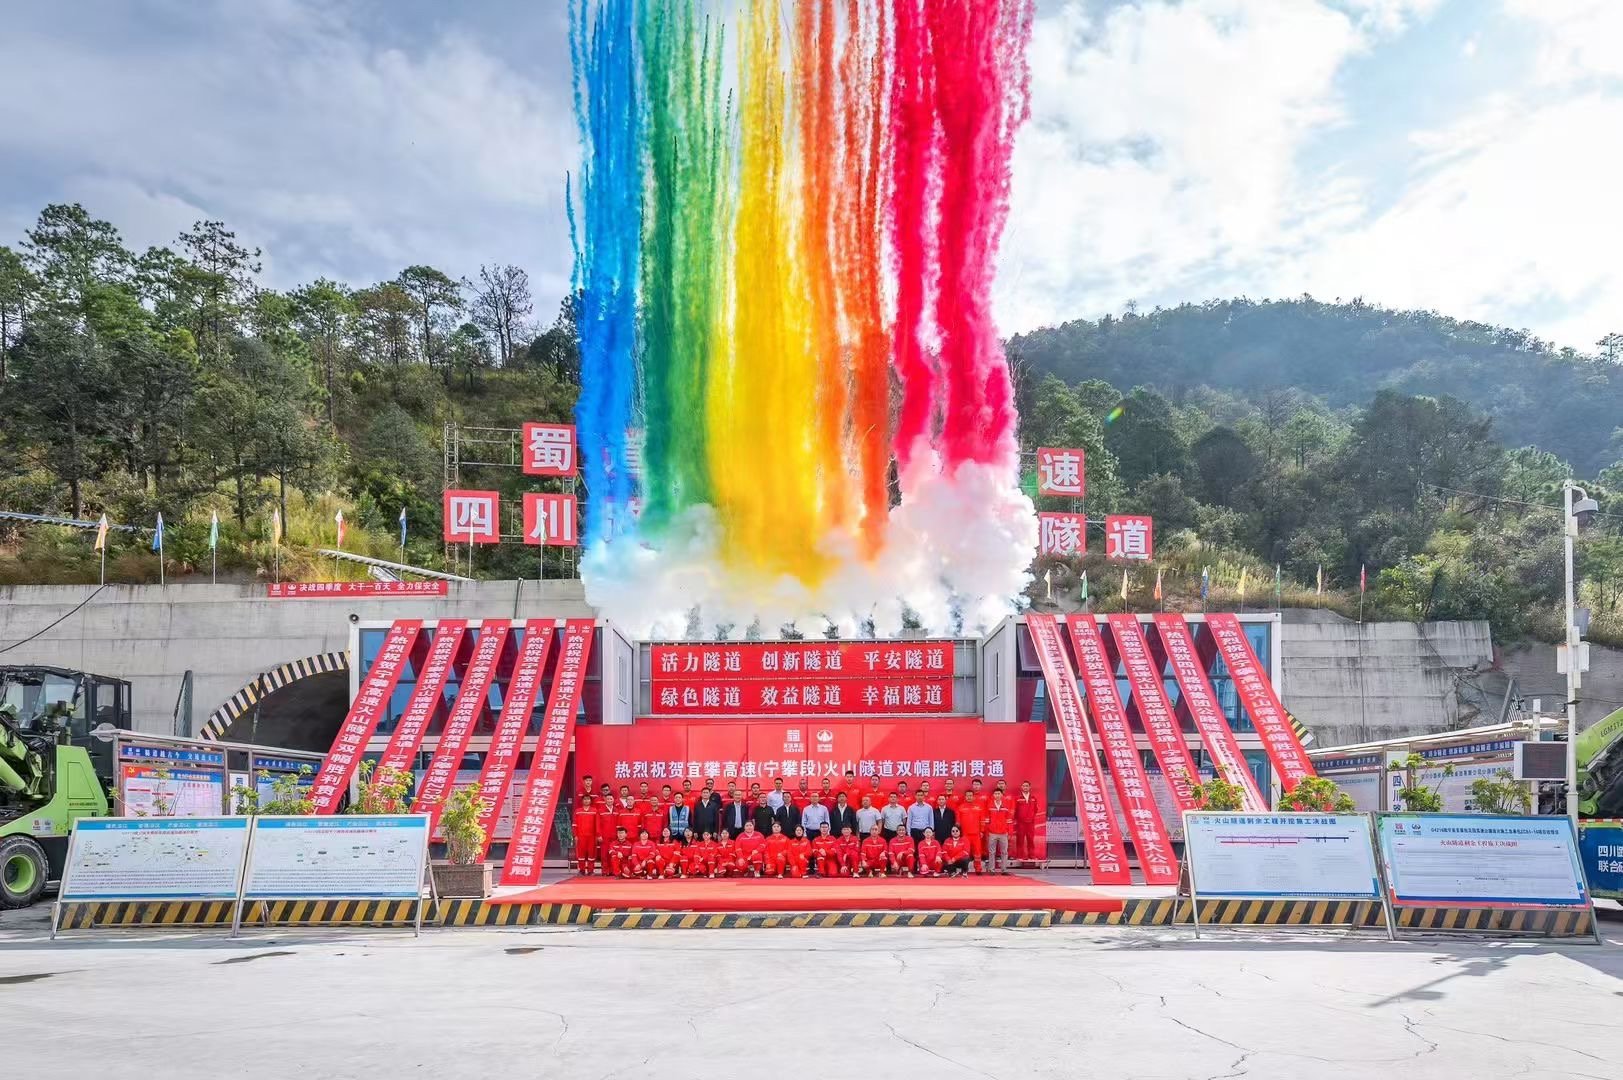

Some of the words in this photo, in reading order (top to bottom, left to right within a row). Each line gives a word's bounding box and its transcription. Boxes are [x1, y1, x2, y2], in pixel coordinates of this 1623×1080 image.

[299, 583, 342, 592] 决战四季度
[348, 582, 391, 591] 大干一百天
[396, 581, 440, 591] 全力保安全
[660, 650, 742, 673] 活力隧道
[761, 649, 843, 672] 创新隧道
[862, 648, 945, 671] 平安隧道
[660, 686, 741, 708] 绿色隧道
[760, 684, 842, 707] 效益隧道
[861, 683, 943, 706] 幸福隧道
[614, 759, 1005, 779] 热烈祝贺宜攀高速(宁攀段)火山隧道双幅胜利贯通
